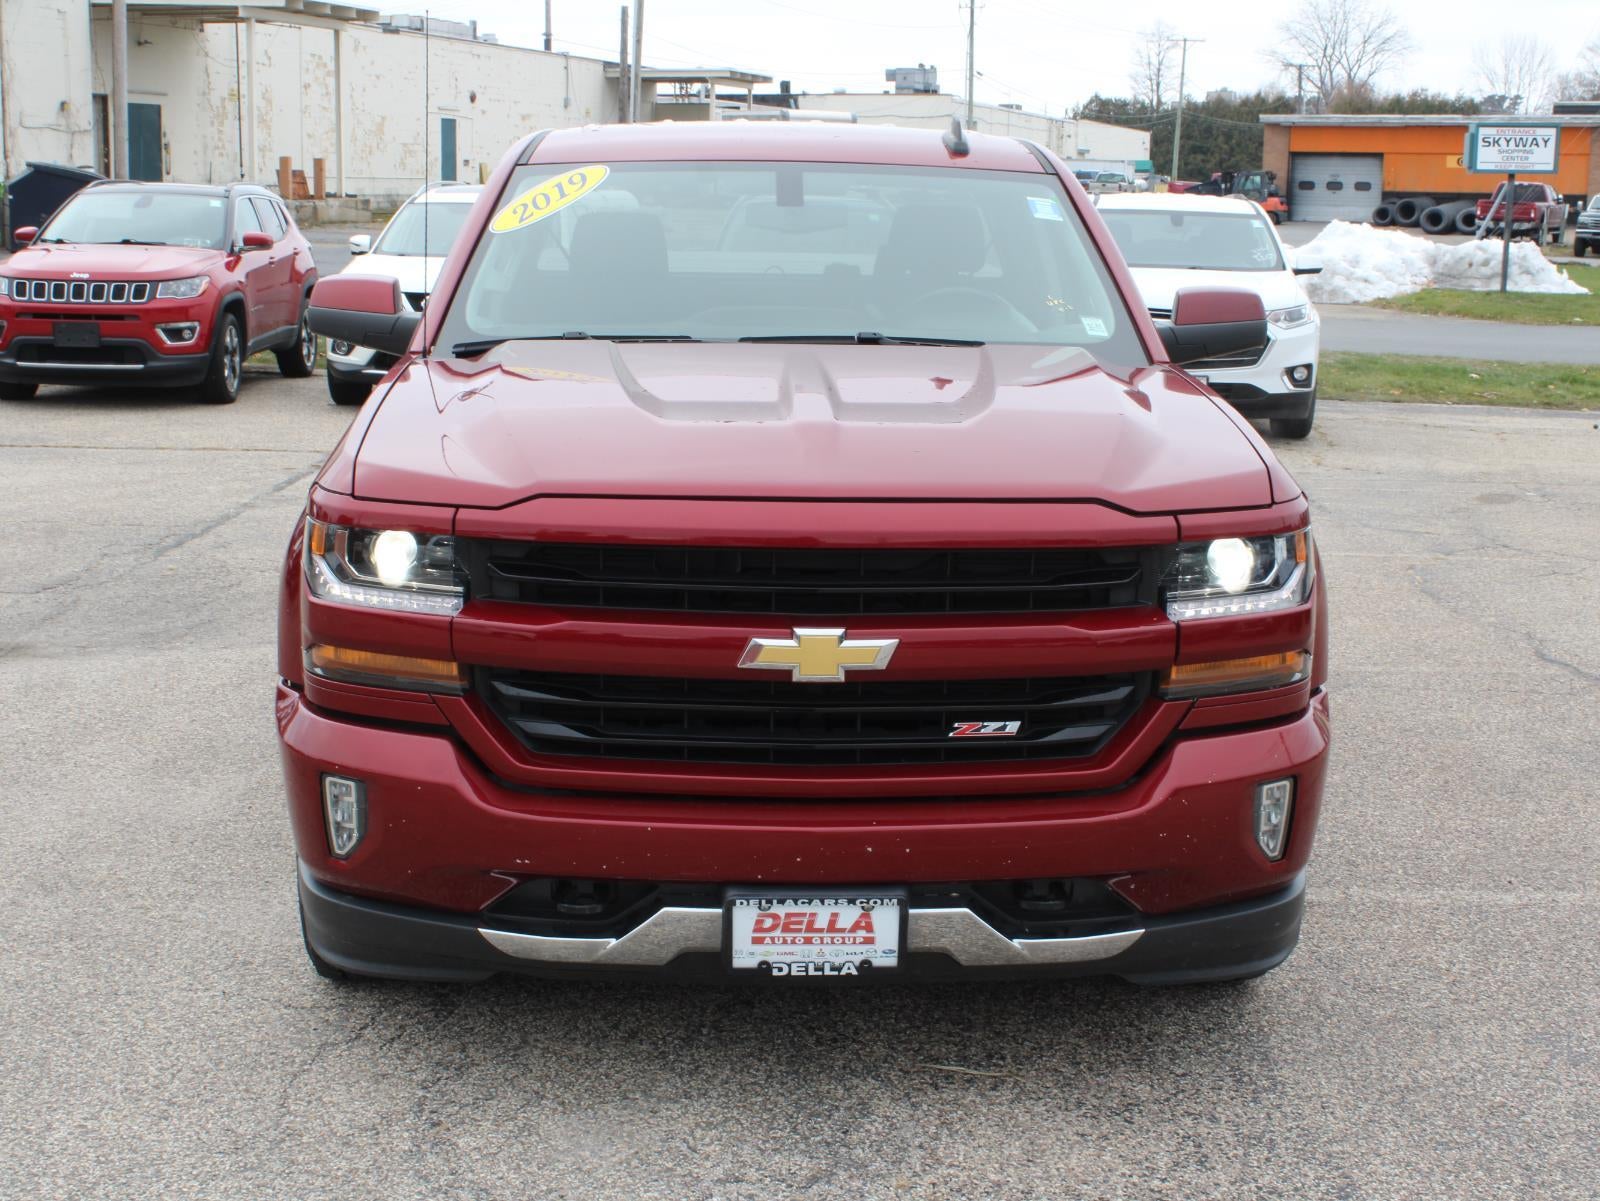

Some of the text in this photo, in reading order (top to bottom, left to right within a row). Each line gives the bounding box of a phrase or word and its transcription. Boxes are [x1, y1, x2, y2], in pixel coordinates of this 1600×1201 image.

[1481, 136, 1551, 148] SKYWAY
[512, 172, 587, 224] 2019
[948, 720, 1021, 737] Z71
[751, 911, 876, 935] DELLA
[763, 936, 865, 945] AUTO GROUP
[771, 961, 859, 977] DELLA
